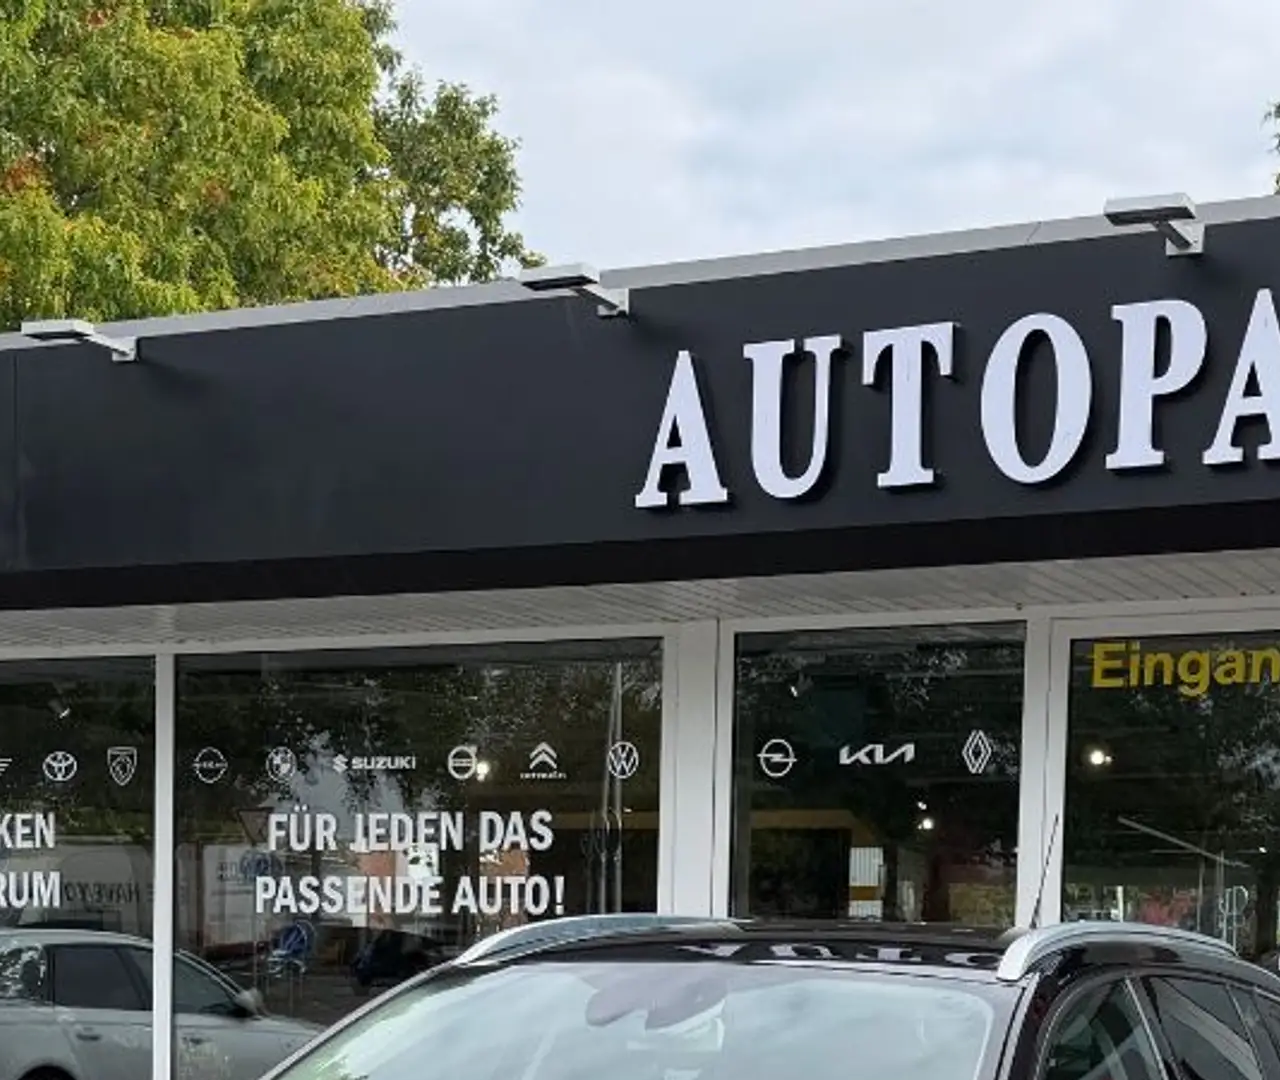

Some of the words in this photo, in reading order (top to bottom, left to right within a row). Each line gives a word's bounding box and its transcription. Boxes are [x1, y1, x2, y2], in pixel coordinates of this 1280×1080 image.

[351, 756, 416, 771] SUZUKI
[268, 805, 337, 851] FÜR
[349, 811, 464, 853] JEDEN
[479, 810, 554, 852] DAS
[255, 876, 443, 914] PASSENDE
[452, 875, 565, 915] AUTO!
